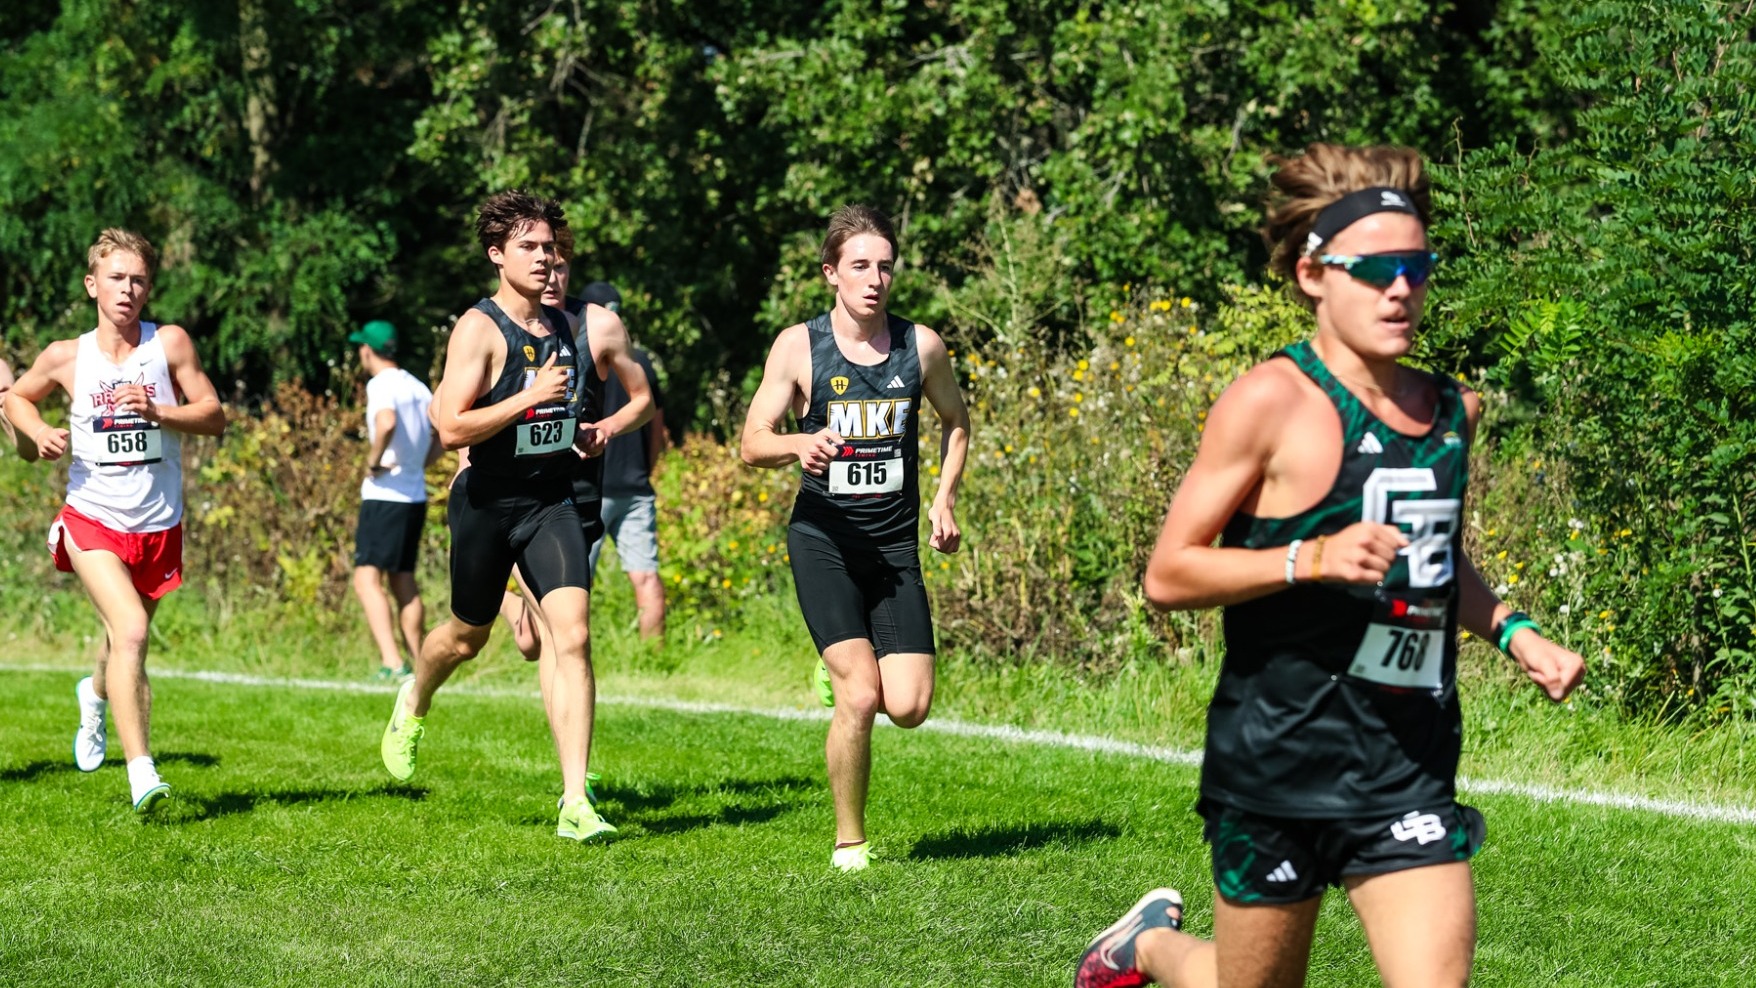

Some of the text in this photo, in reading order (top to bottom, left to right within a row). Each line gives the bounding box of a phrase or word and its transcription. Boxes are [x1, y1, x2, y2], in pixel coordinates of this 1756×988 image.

[827, 398, 912, 440] MKE
[107, 432, 148, 454] 658
[530, 421, 563, 446] 623
[847, 462, 887, 485] 615
